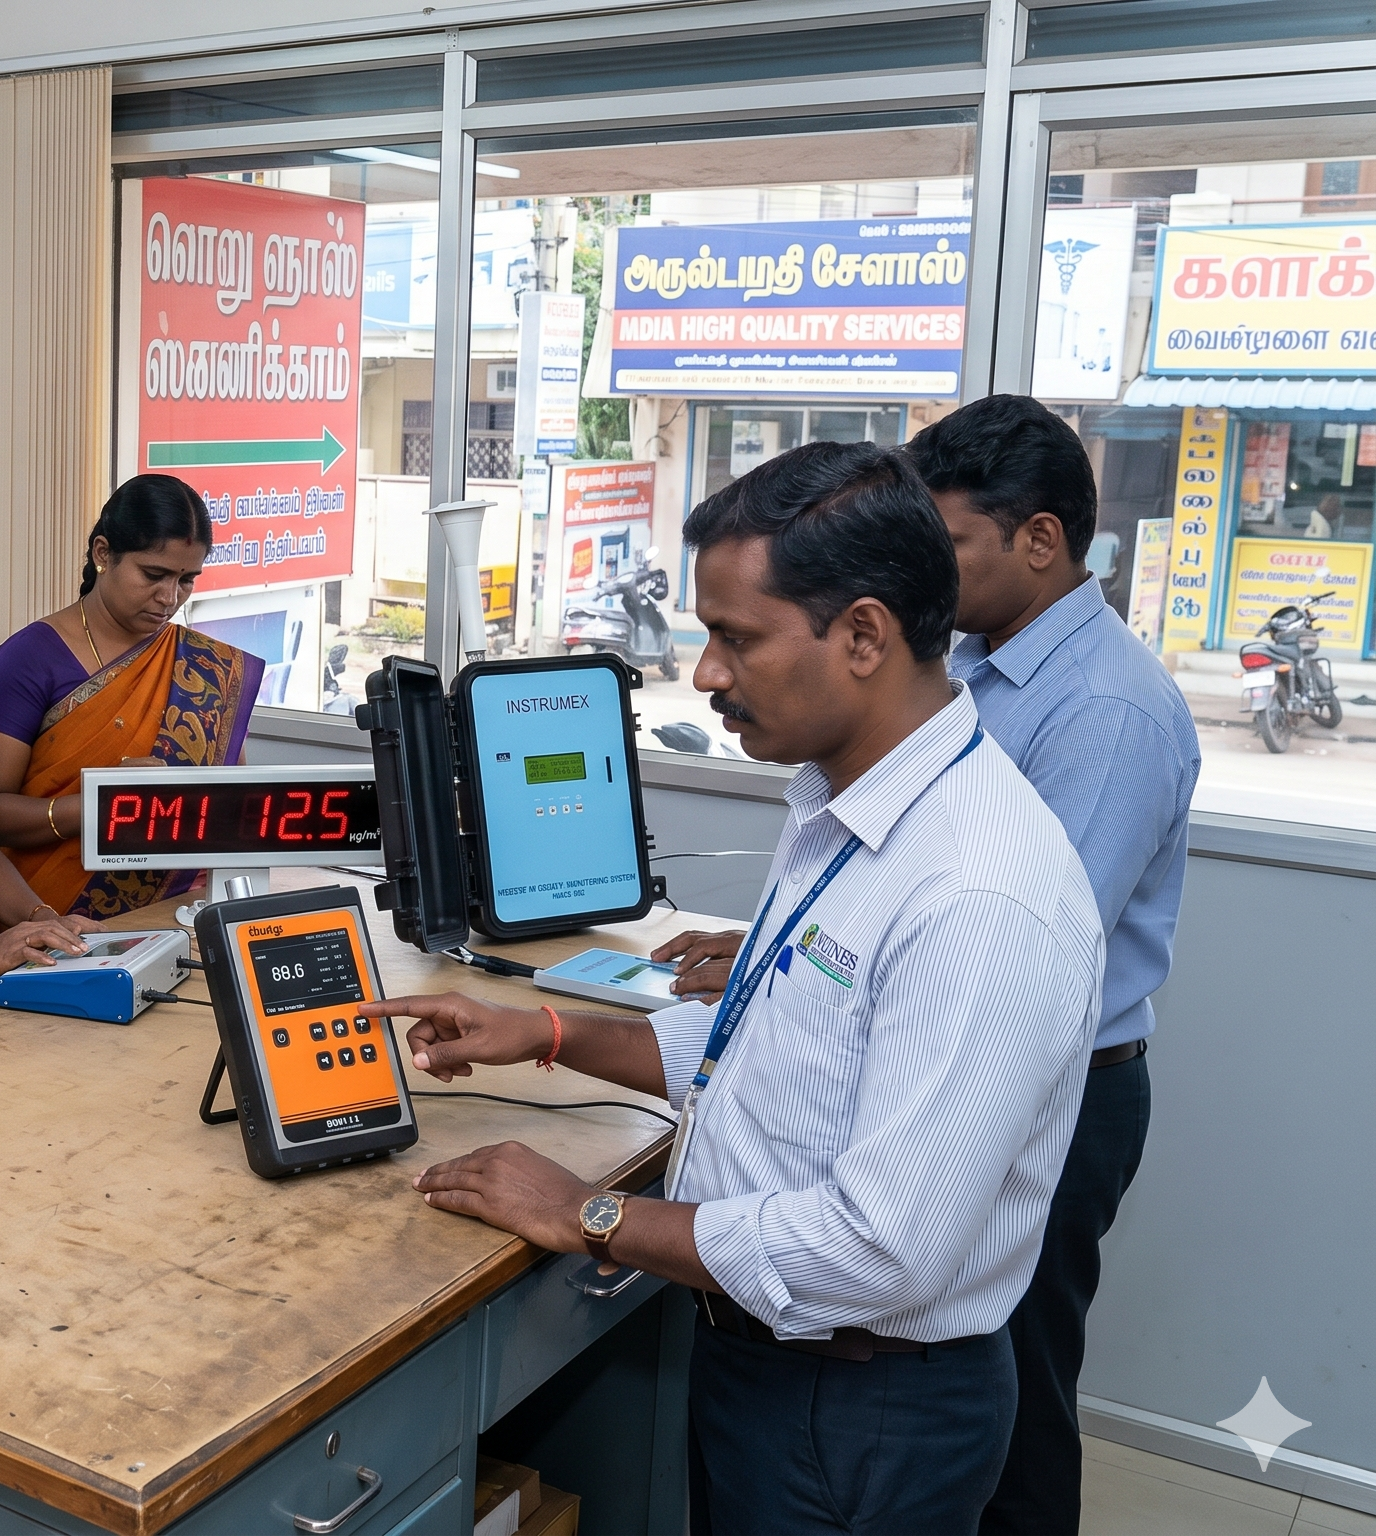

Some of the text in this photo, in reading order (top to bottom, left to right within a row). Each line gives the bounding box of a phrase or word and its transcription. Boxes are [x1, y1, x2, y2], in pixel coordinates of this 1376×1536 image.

[619, 313, 961, 343] MDIA HIGH QUALITY SERVICES
[506, 694, 590, 714] INSTRUMEX
[260, 791, 349, 840] 12.5
[271, 963, 305, 982] 88.6
